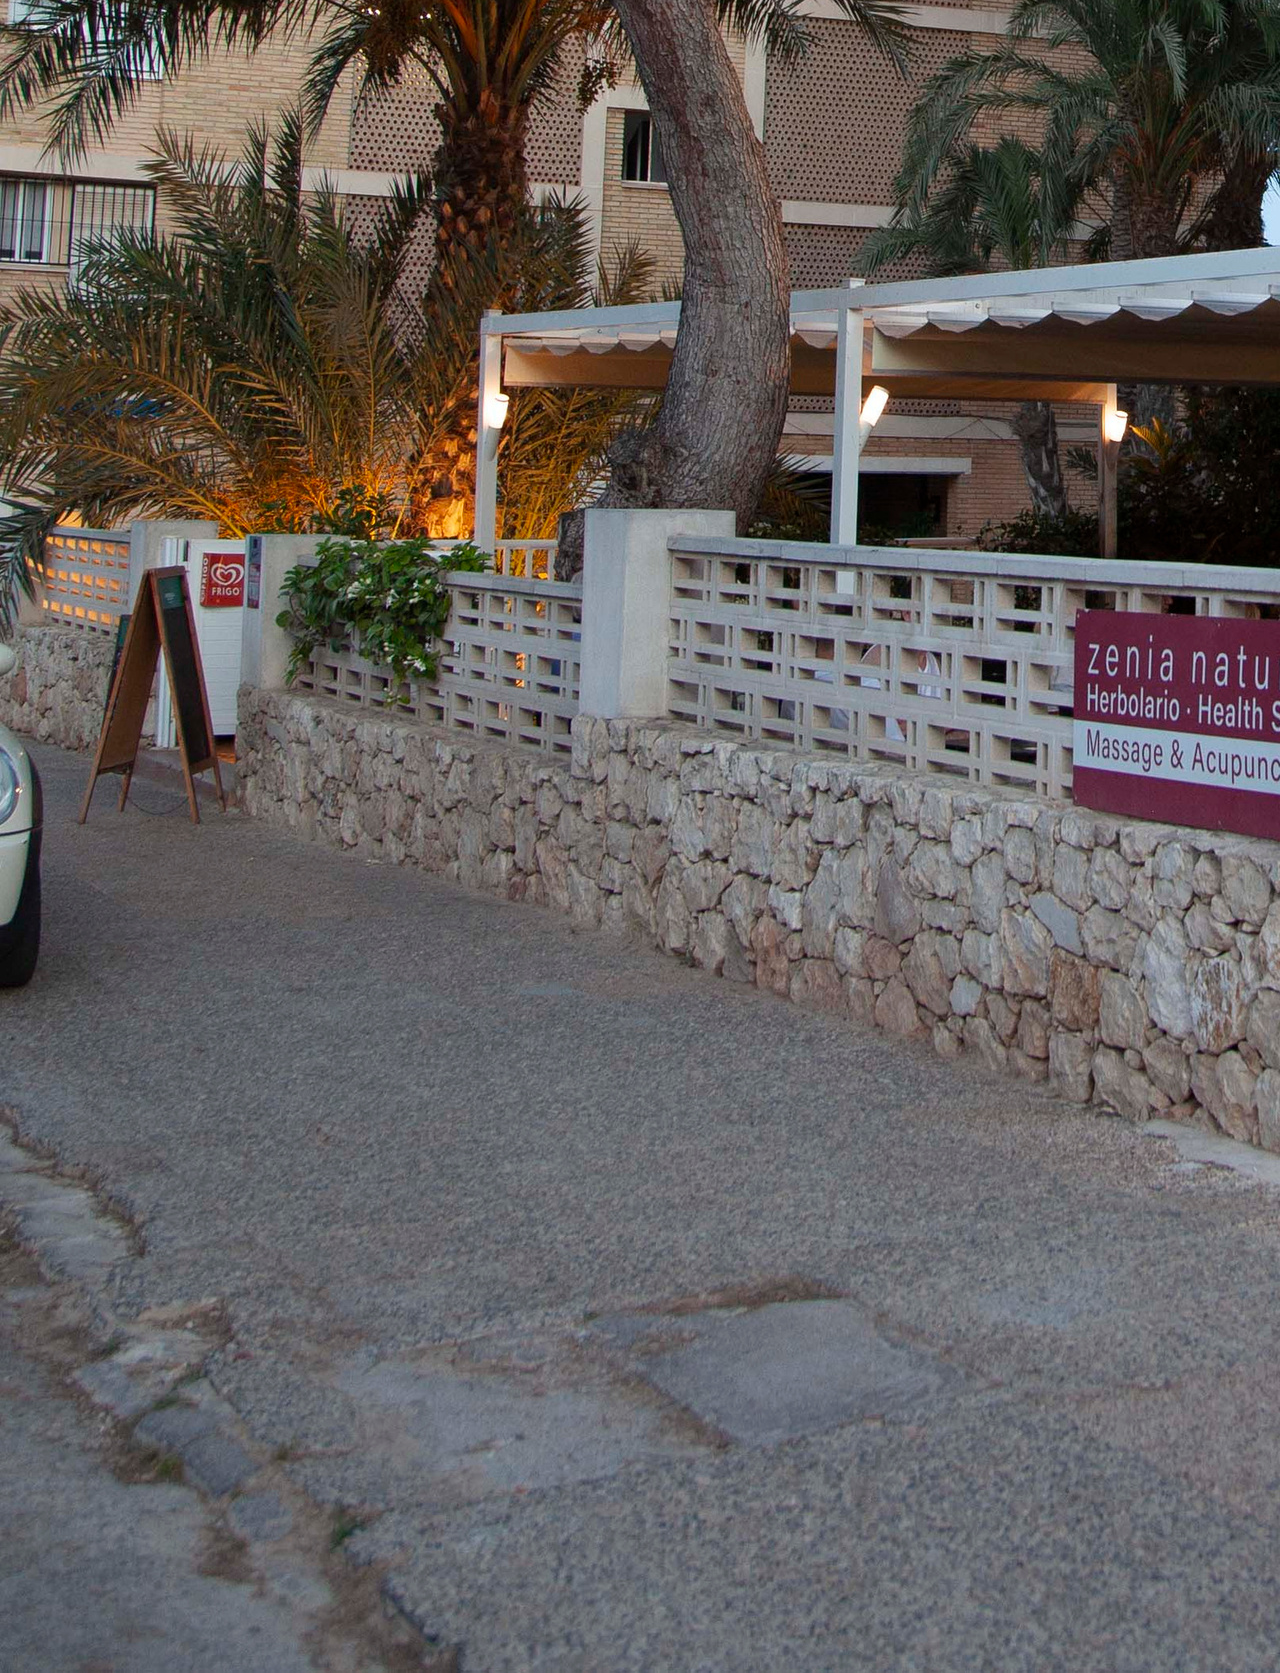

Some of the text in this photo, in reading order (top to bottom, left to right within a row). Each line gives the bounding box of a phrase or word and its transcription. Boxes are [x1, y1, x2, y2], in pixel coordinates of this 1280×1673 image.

[211, 587, 240, 596] FRIGO
[1087, 635, 1174, 682] zenia
[1086, 682, 1180, 721] Herbolario
[1198, 693, 1263, 730] Health
[1086, 728, 1163, 772] Massage
[1170, 739, 1184, 769] &
